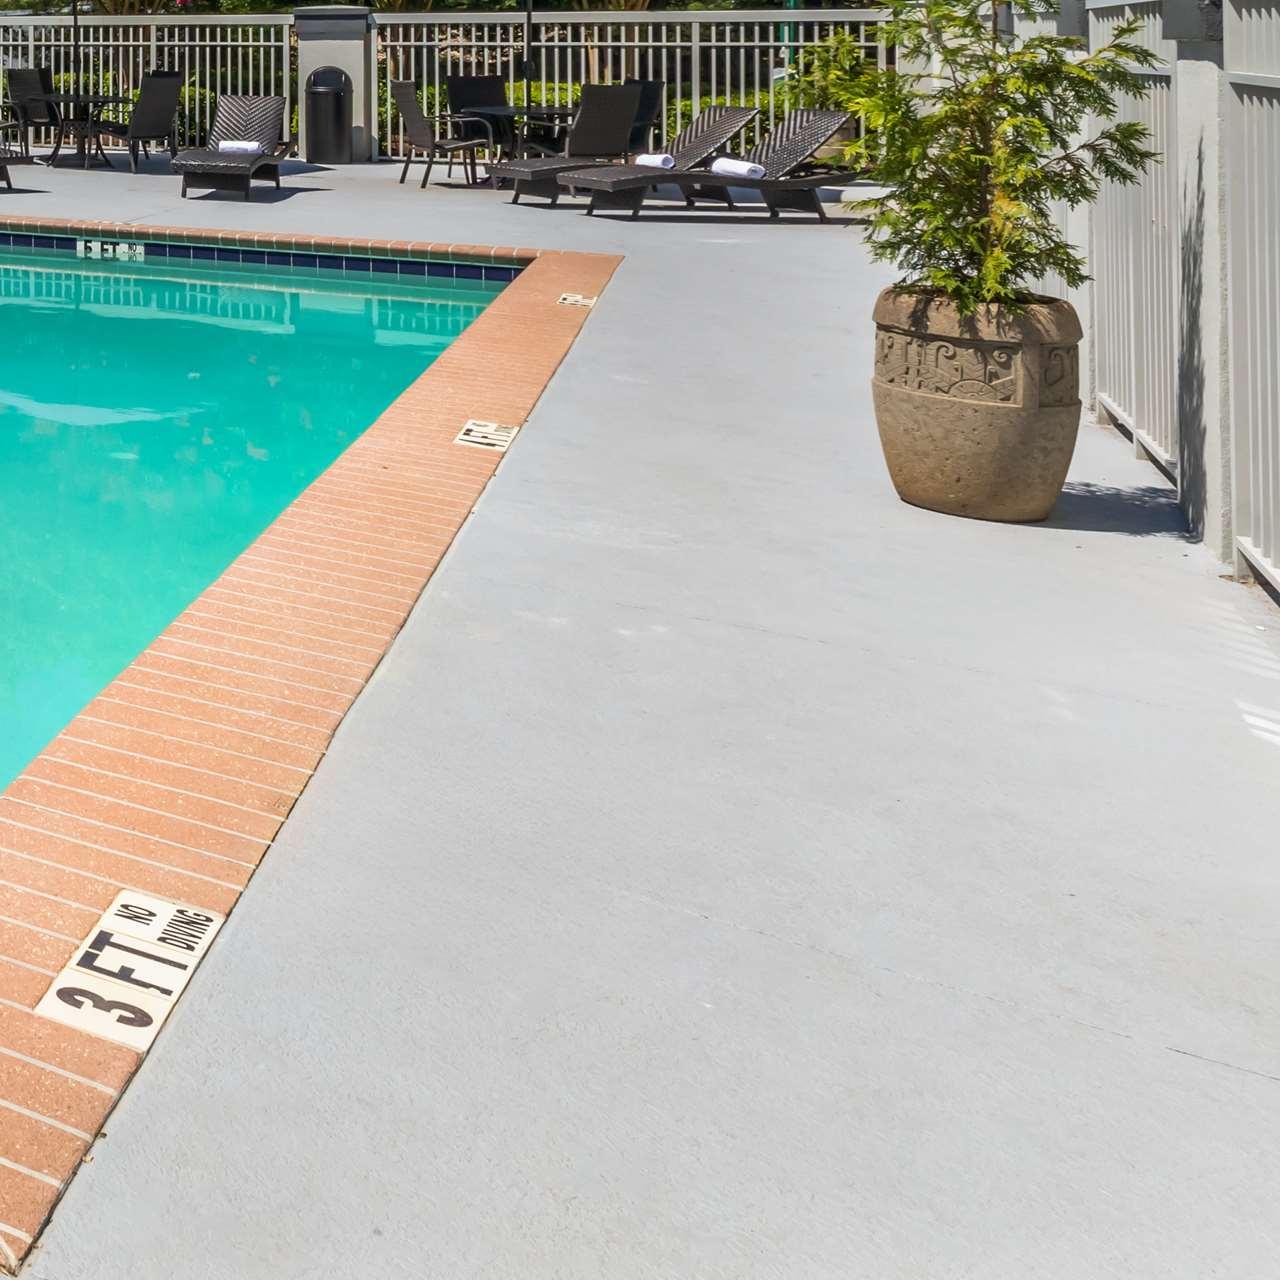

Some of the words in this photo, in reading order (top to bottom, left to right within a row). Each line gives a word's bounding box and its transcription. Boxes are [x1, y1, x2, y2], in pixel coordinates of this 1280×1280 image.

[84, 240, 93, 254] 5
[101, 241, 120, 255] FT
[114, 903, 158, 926] NO
[156, 908, 214, 952] DIVING
[76, 929, 189, 997] FT
[55, 986, 154, 1028] 3
